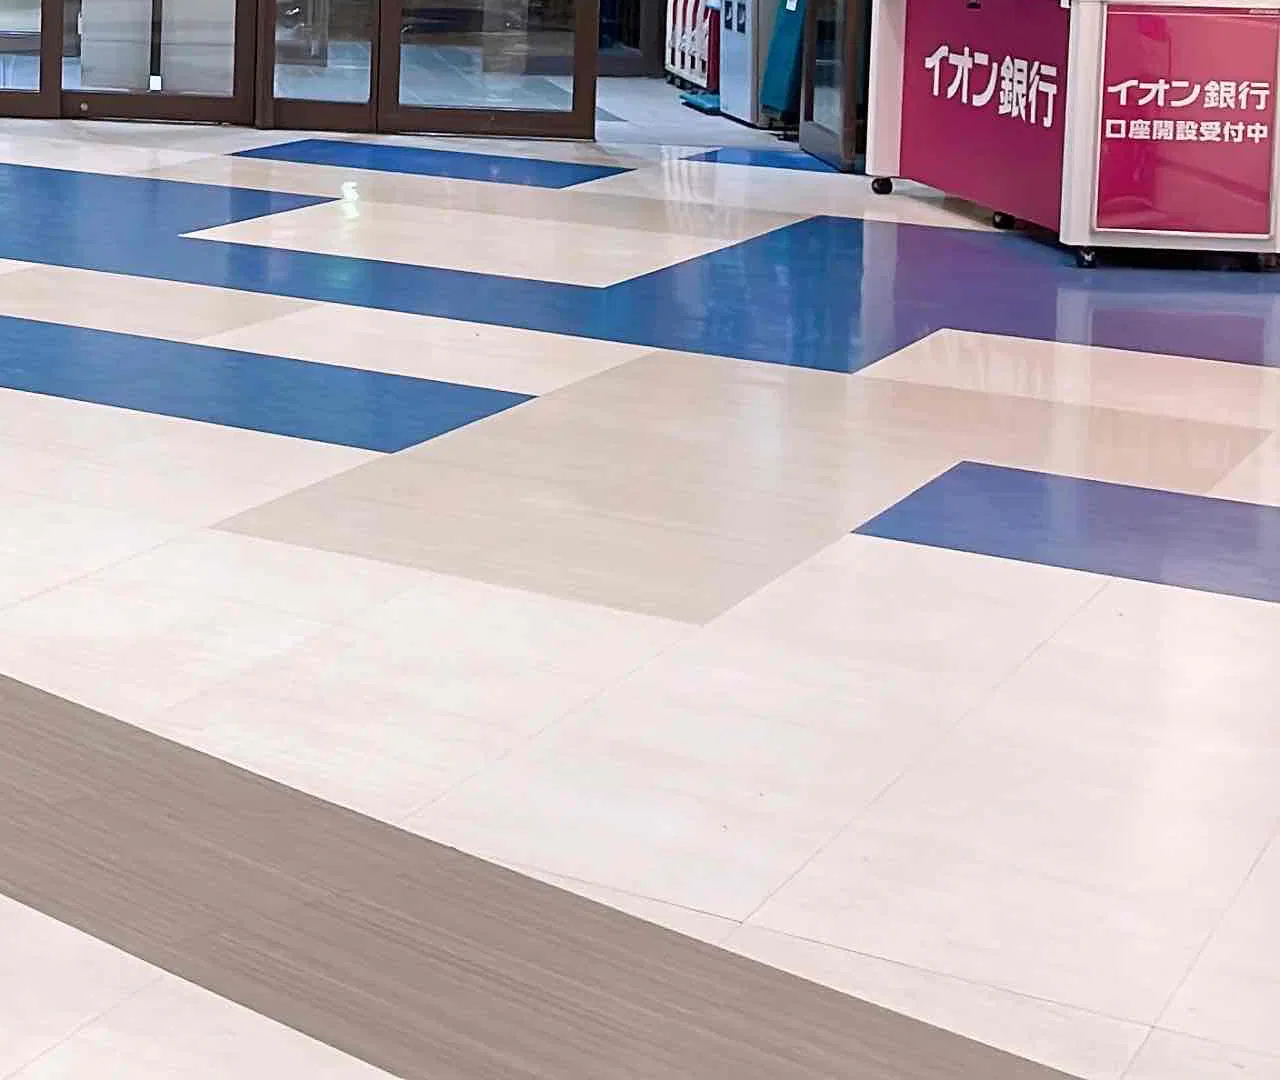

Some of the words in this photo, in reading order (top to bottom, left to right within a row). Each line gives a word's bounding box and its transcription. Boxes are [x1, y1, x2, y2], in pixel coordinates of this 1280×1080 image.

[924, 43, 1058, 128] イオン銀行
[1107, 79, 1270, 110] イオン銀行
[1105, 118, 1269, 145] 口座開設受付中
